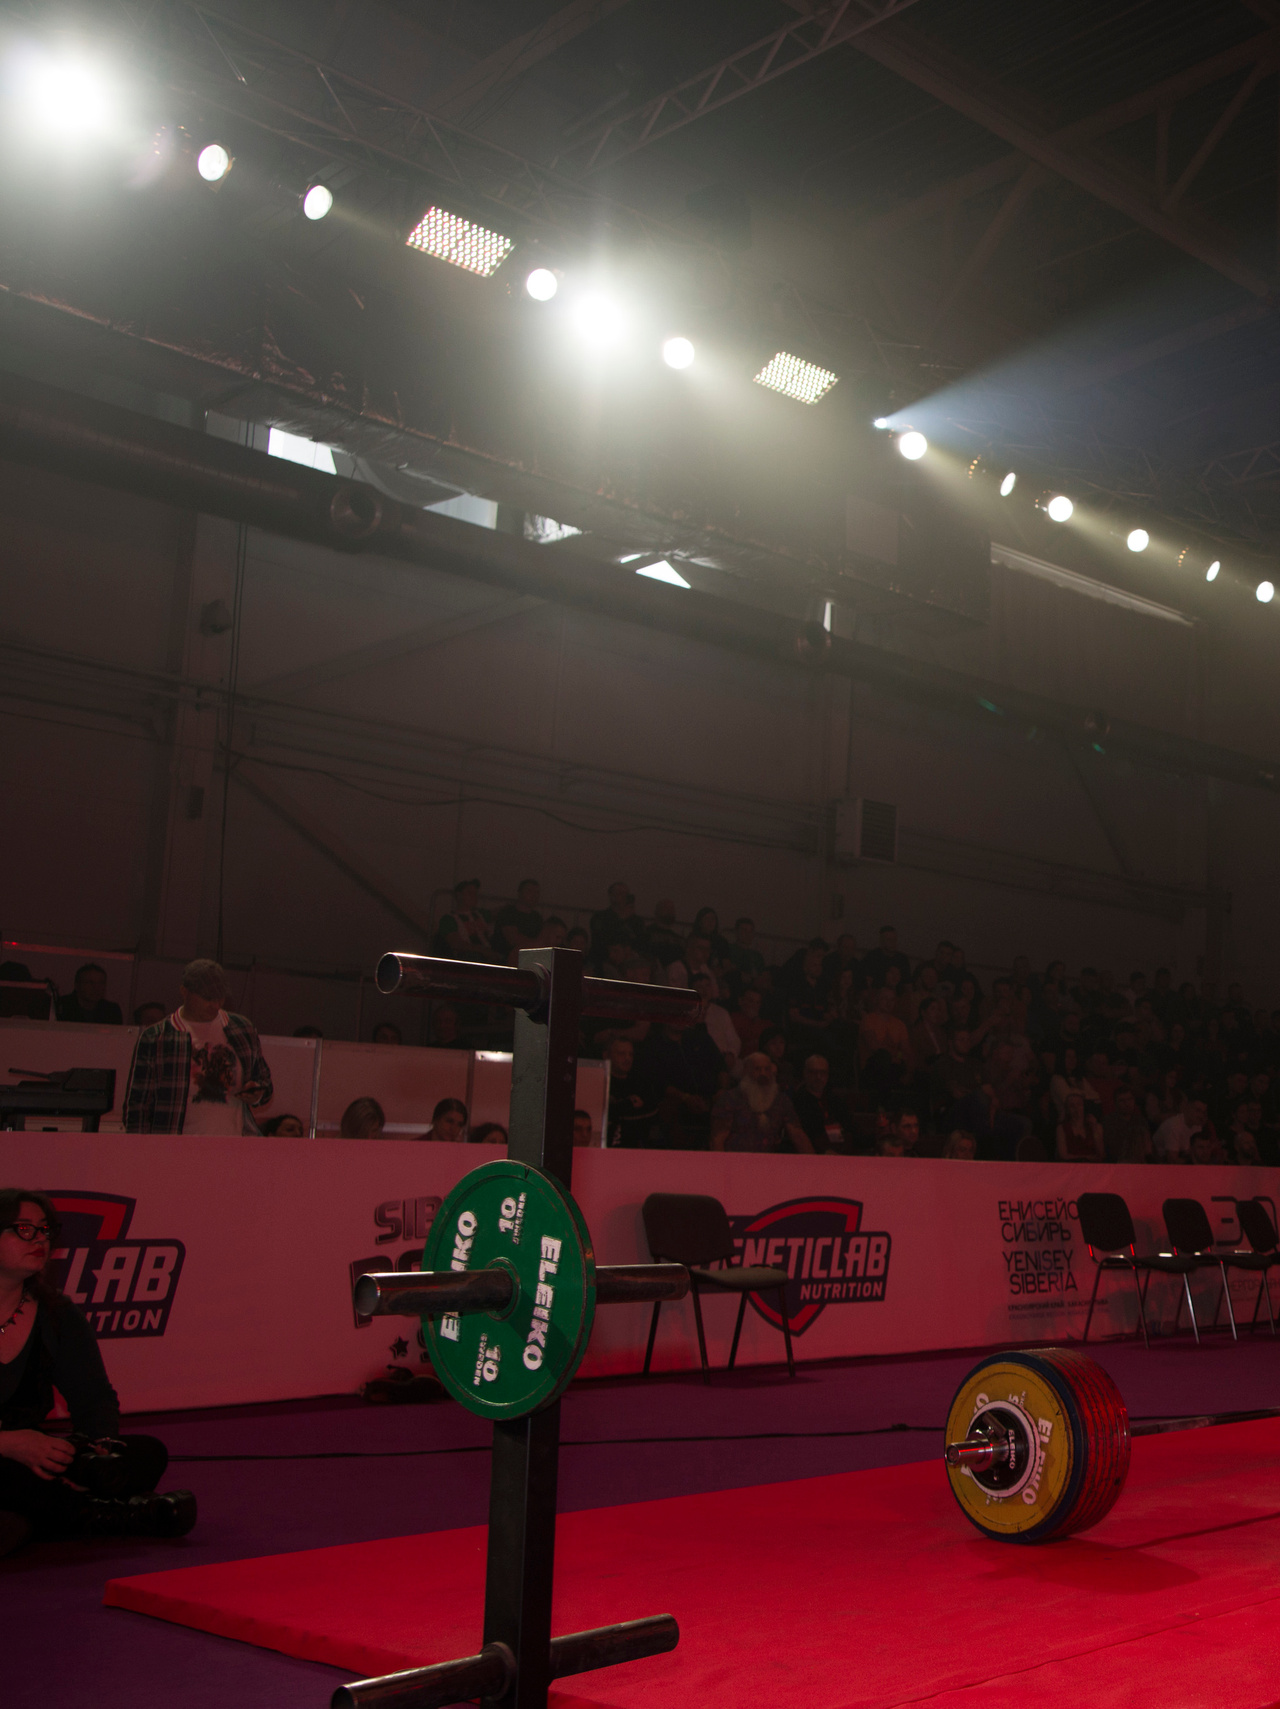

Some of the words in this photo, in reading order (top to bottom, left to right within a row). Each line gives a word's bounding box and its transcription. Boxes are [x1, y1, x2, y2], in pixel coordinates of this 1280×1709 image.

[498, 1196, 518, 1234] 10
[1001, 1222, 1072, 1242] СИБИРЬ
[1002, 1249, 1074, 1272] YENISEY
[800, 1281, 884, 1301] NUTRITION
[1010, 1271, 1078, 1295] SIBERIA
[522, 1233, 563, 1372] ELEIKO
[481, 1344, 502, 1383] 10
[1008, 1428, 1016, 1471] ELEIKO
